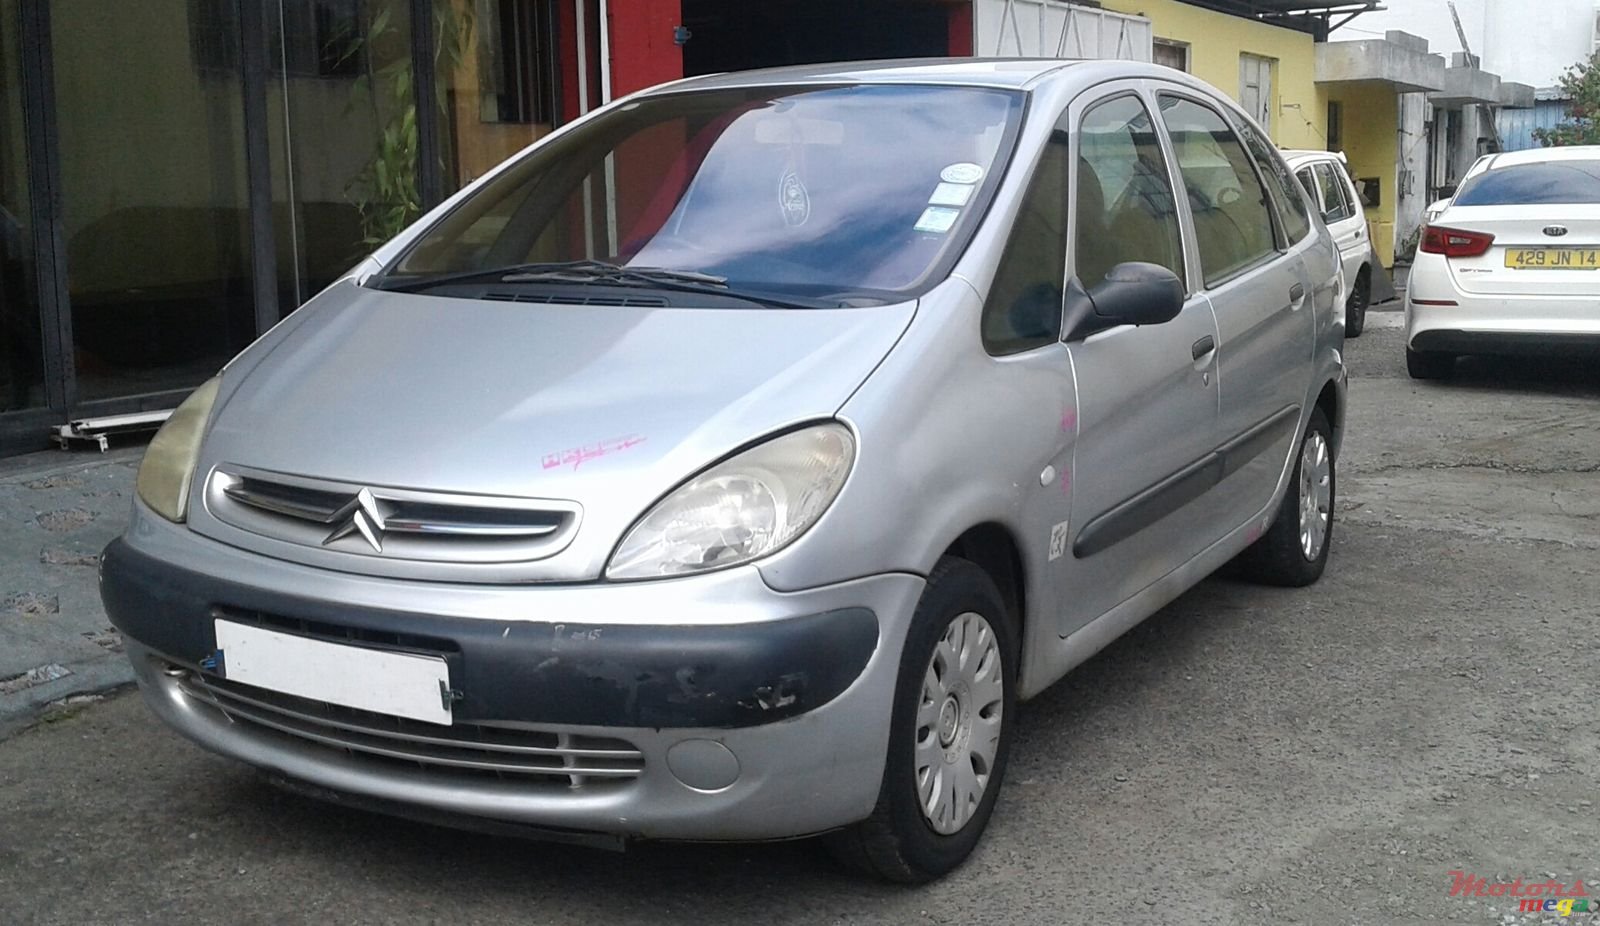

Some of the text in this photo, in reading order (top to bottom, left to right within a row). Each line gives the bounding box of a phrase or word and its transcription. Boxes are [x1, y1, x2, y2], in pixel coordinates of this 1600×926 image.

[1515, 251, 1596, 265] 429 JN 14
